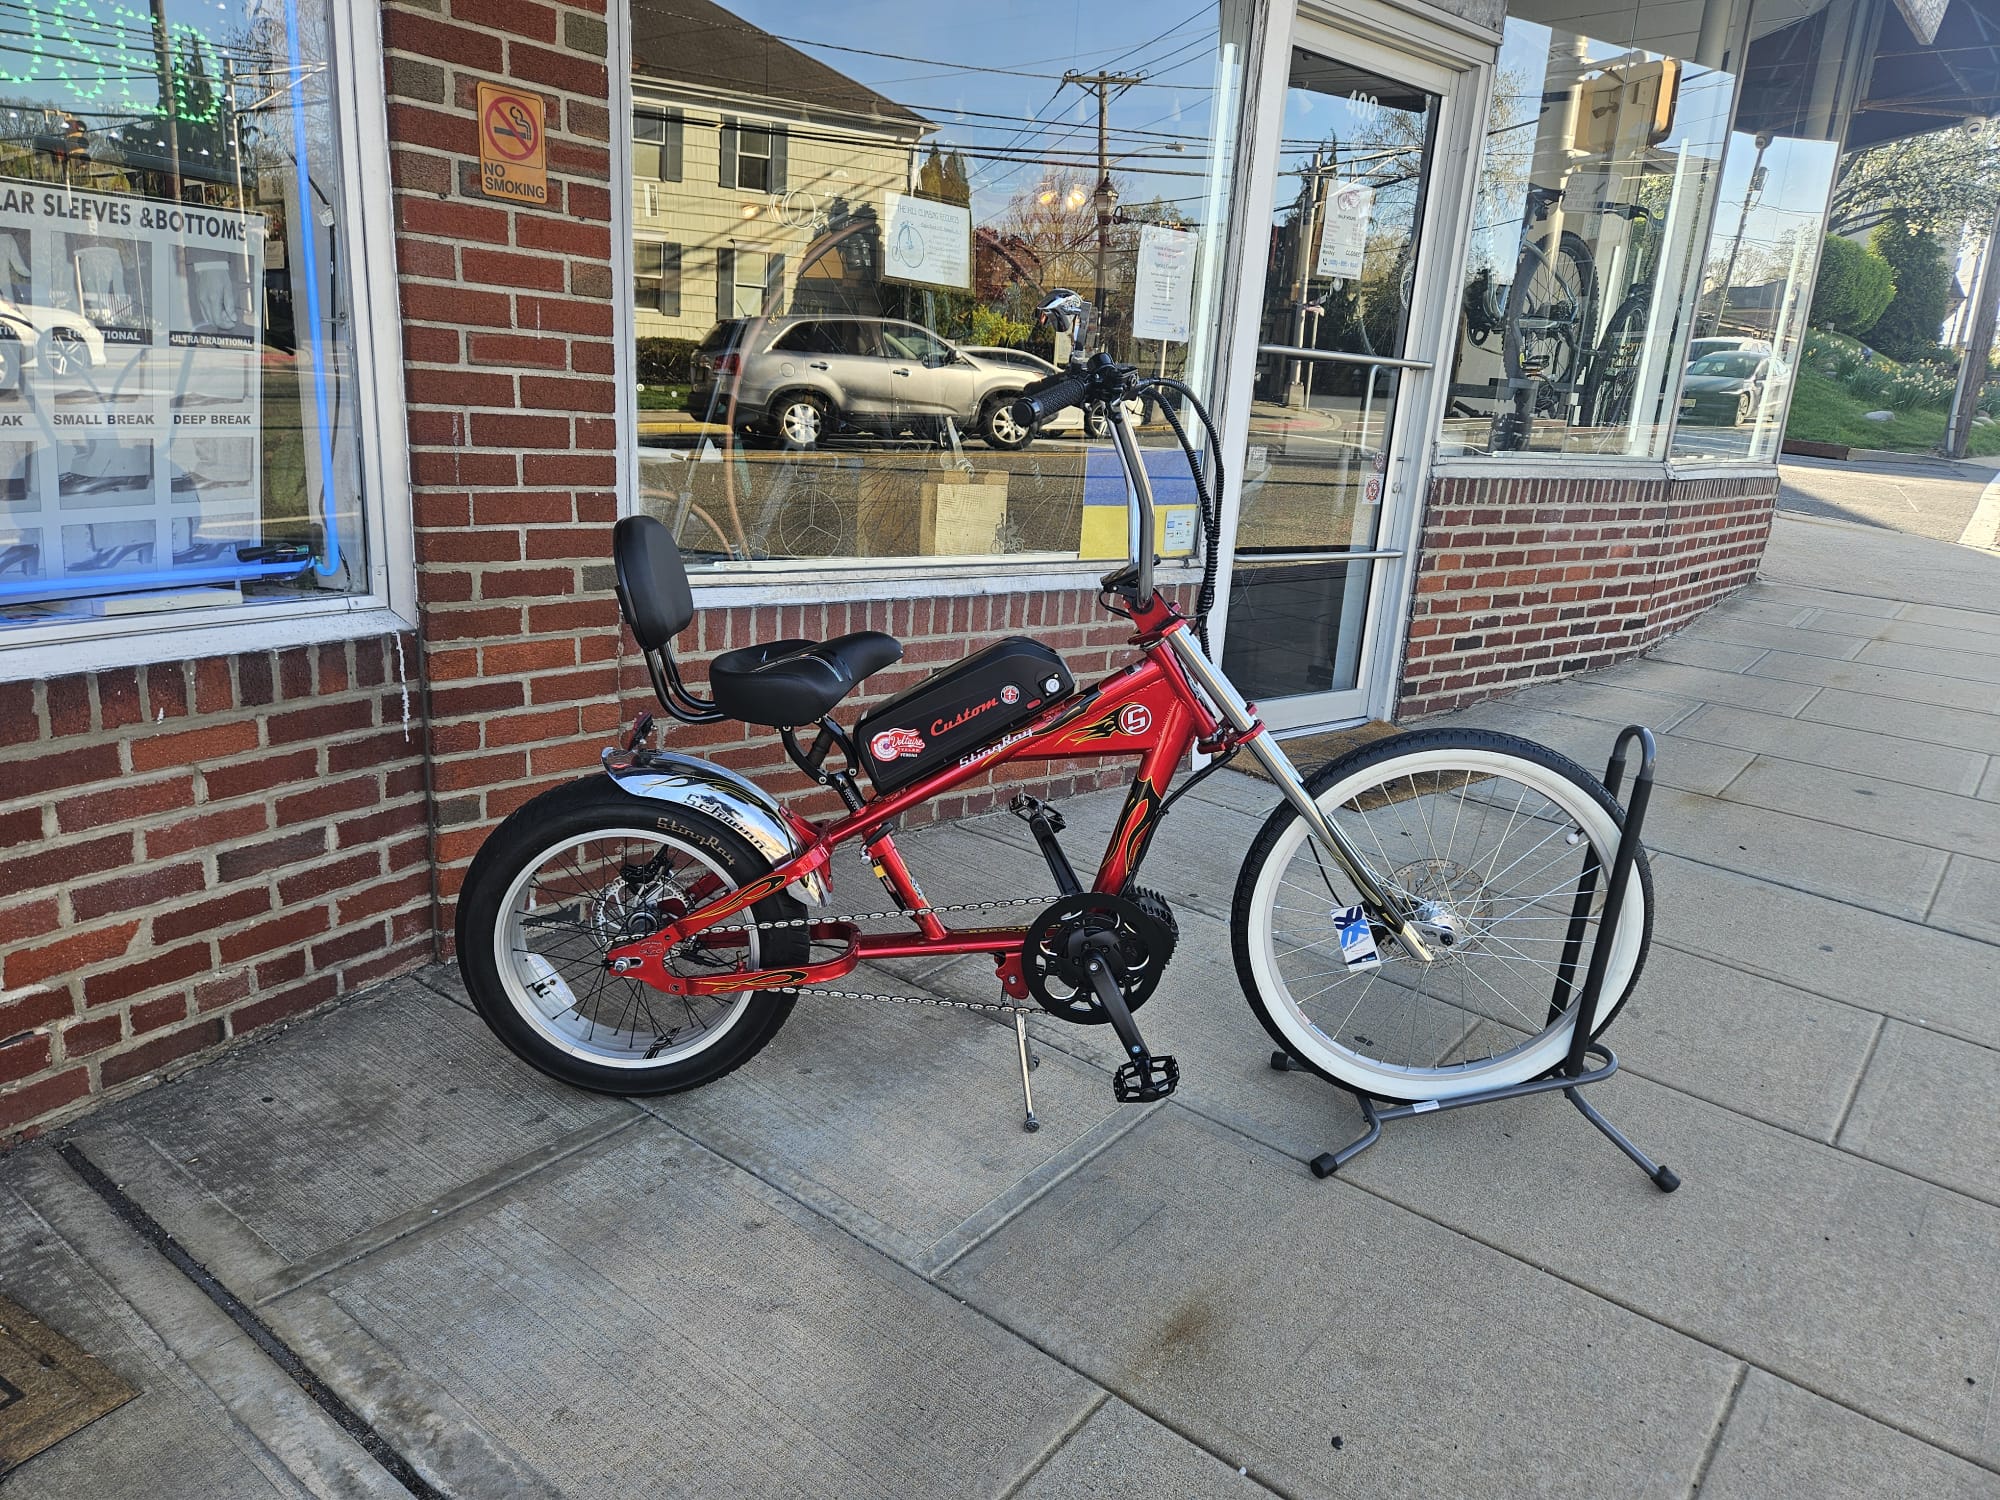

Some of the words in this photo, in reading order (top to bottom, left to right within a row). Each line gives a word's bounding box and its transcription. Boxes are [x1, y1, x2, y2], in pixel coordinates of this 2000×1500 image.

[484, 162, 505, 177] NO
[485, 177, 545, 199] SMOKING
[0, 189, 34, 214] AR
[43, 193, 131, 226] SLEEVES
[139, 207, 246, 242] &BOTTOMS
[171, 333, 199, 344] ULTRA
[201, 335, 253, 347] TRADITIONAL
[0, 415, 23, 426] AK
[53, 414, 102, 425] SMALL
[107, 414, 155, 425] BREAK
[173, 414, 206, 425] DEEP
[211, 414, 251, 425] BREAK
[930, 697, 999, 737] Custom
[1127, 706, 1146, 732] S
